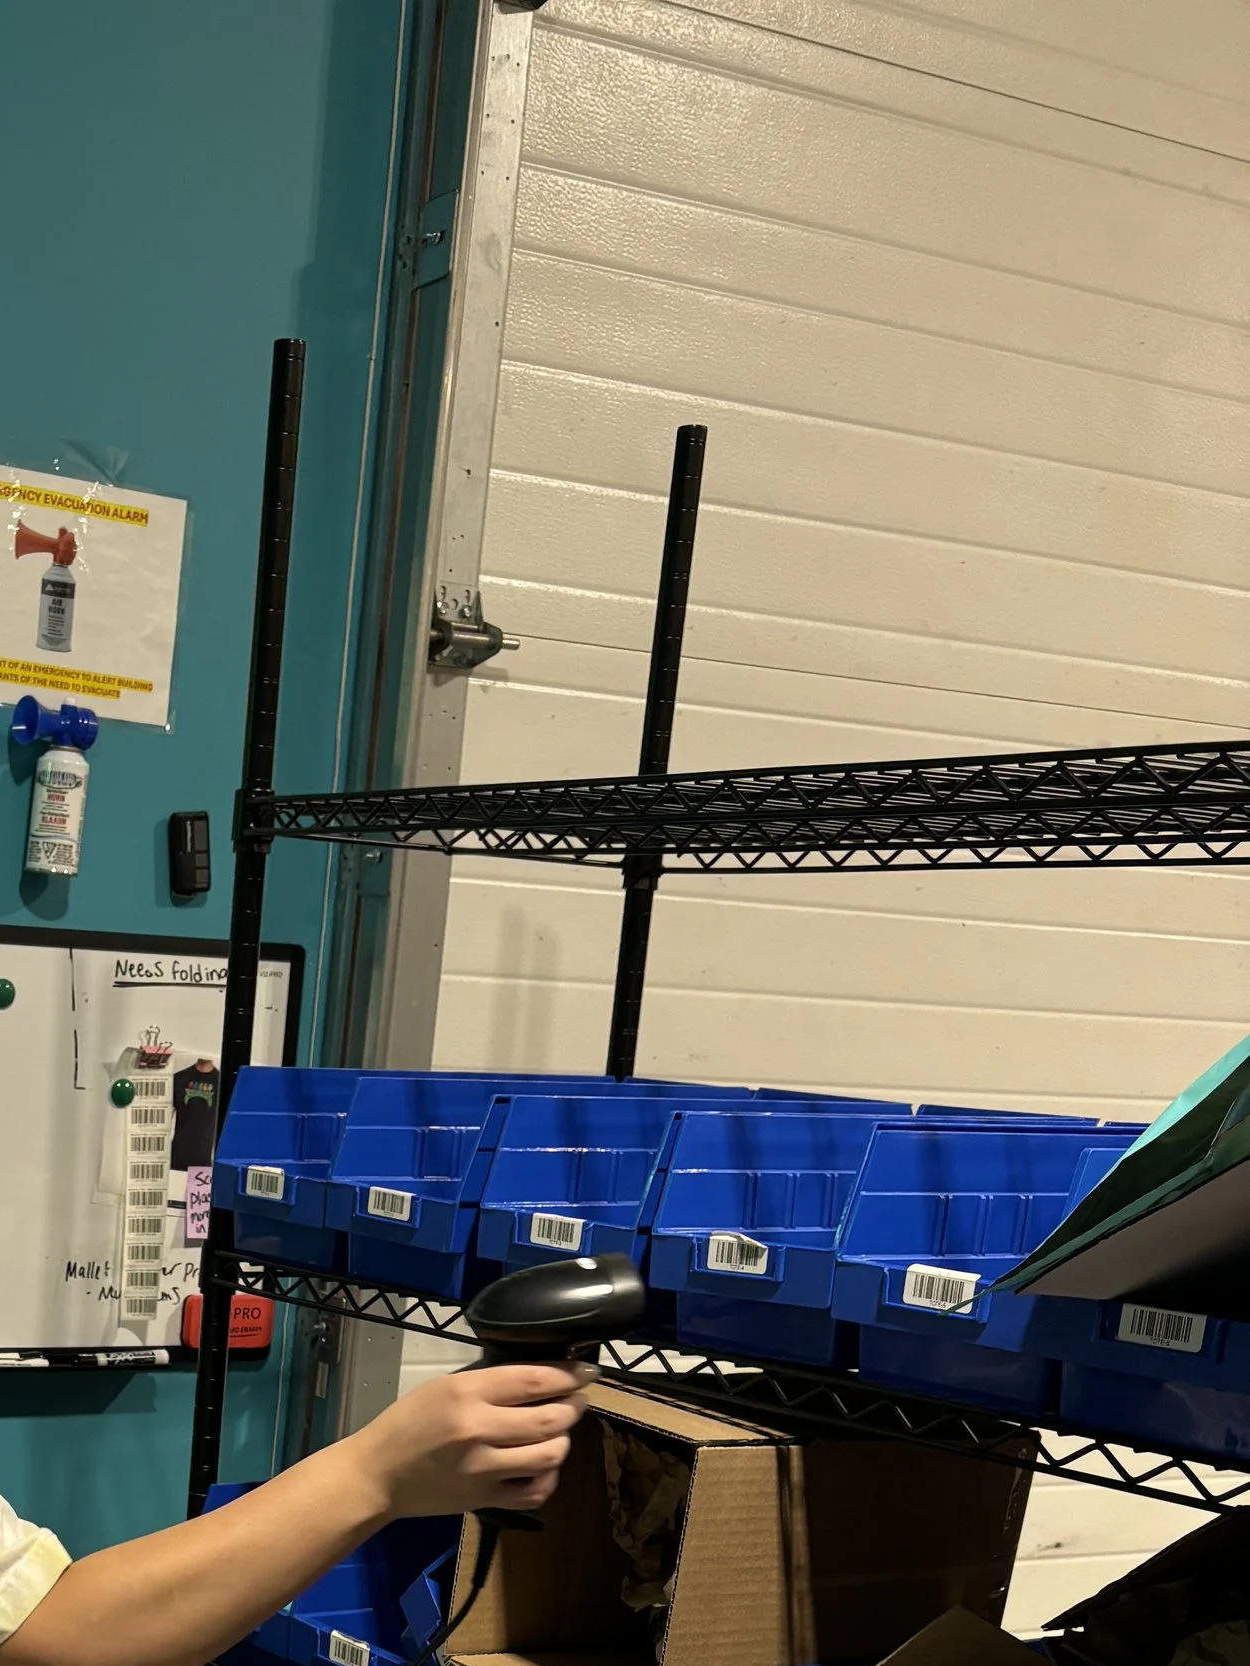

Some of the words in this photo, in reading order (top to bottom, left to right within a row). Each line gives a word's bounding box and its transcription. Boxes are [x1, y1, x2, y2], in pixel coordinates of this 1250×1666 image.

[43, 492, 111, 517] EVACUATION
[111, 507, 149, 524] ALARM
[8, 659, 20, 670] OF
[20, 661, 32, 672] AN
[33, 663, 81, 681] EMERGENCY
[81, 670, 92, 682] TO
[92, 672, 117, 686] ALERT
[117, 677, 153, 692] BUILDING
[20, 673, 31, 684] OF
[32, 675, 48, 687] THE
[48, 678, 71, 691] NEED
[71, 681, 81, 692] TO
[81, 683, 121, 698] EVACUATE
